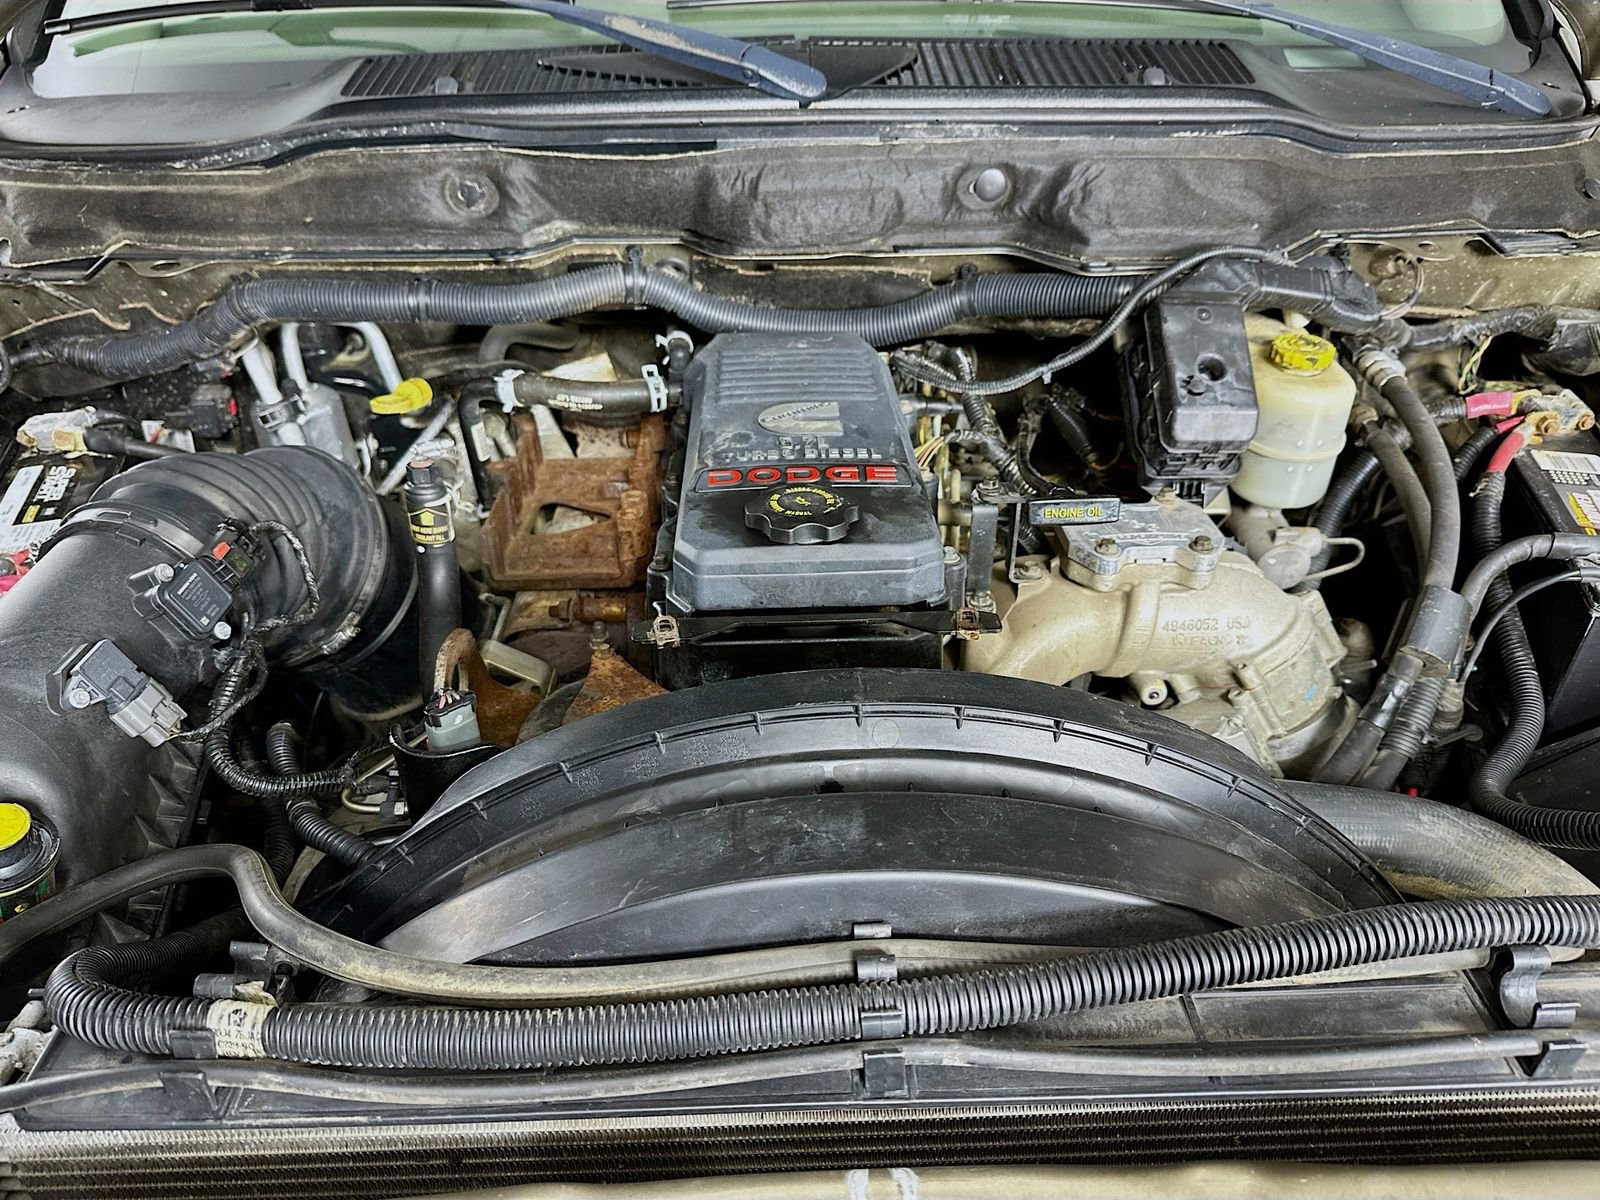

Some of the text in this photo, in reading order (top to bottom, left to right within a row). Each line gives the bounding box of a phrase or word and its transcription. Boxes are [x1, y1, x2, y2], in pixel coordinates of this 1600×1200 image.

[722, 447, 883, 463] TURBO DIESEL
[707, 465, 899, 486] DODGE
[1044, 506, 1104, 519] ENGINE OIL
[1161, 617, 1219, 632] 4946052
